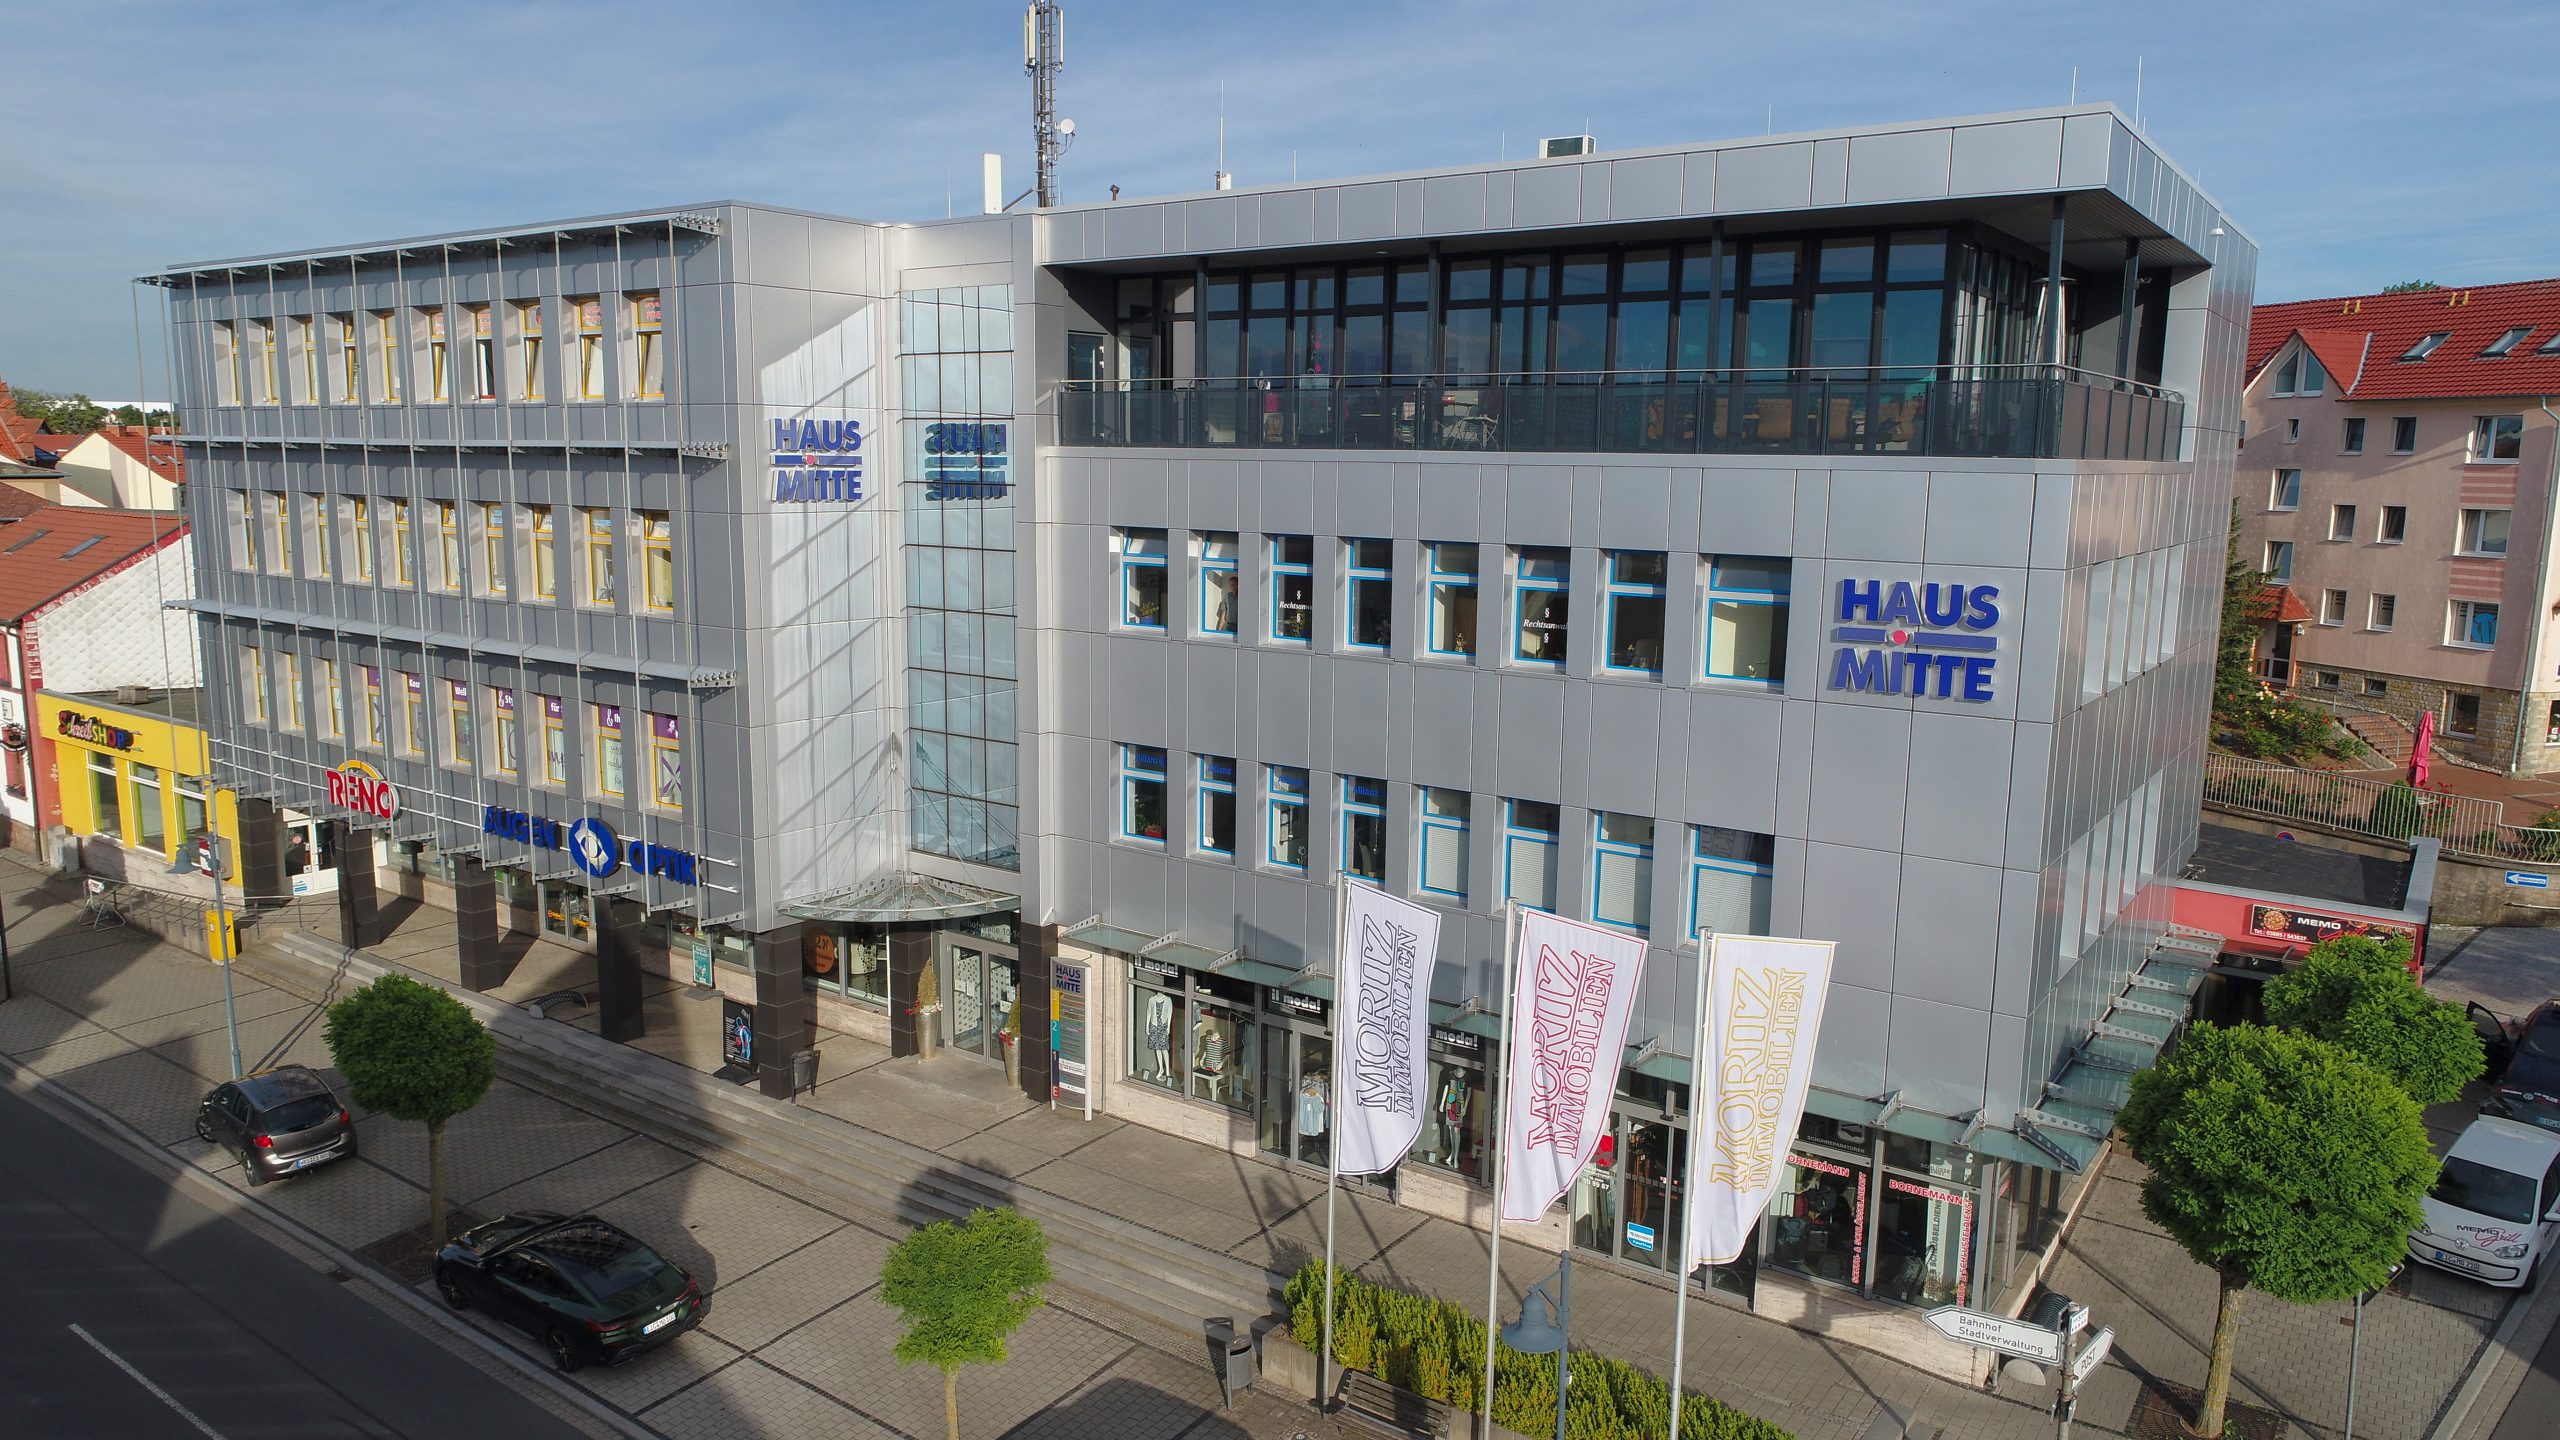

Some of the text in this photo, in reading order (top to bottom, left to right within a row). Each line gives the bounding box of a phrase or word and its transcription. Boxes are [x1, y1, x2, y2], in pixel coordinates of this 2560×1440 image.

[772, 418, 862, 451] HAUS
[773, 470, 863, 501] MITTE
[1841, 578, 2000, 630] HAUS
[1523, 619, 1568, 630] Rechtsanwal
[1834, 647, 1997, 701] MITTE
[325, 769, 396, 820] RENO
[484, 805, 702, 888] AUGEN OPTIK
[2297, 917, 2342, 930] MEMO
[1056, 965, 1081, 979] HAUS
[1144, 961, 1179, 976] moda!
[1056, 979, 1081, 993] MITTE
[1271, 988, 1321, 1011] il moda!
[1052, 1021, 1058, 1032] 2
[1391, 925, 1418, 1119] IMMOBILIEN
[1435, 1029, 1478, 1048] moda!
[1052, 1050, 1057, 1061] 1
[1553, 954, 1616, 1159] IMMOBILIEN
[1749, 967, 1807, 1190] IMMOBILIEN
[1053, 1086, 1059, 1097] E
[1787, 1155, 1850, 1178] ORNEMANN
[1888, 1178, 1964, 1206] BORNEMANN
[2456, 1224, 2500, 1236] MEMO
[2474, 1227, 2522, 1248] Grill
[1959, 1316, 2002, 1333] Bahnhof
[1958, 1327, 2044, 1355] Stadtverwaltung
[2080, 1347, 2097, 1375] POST
